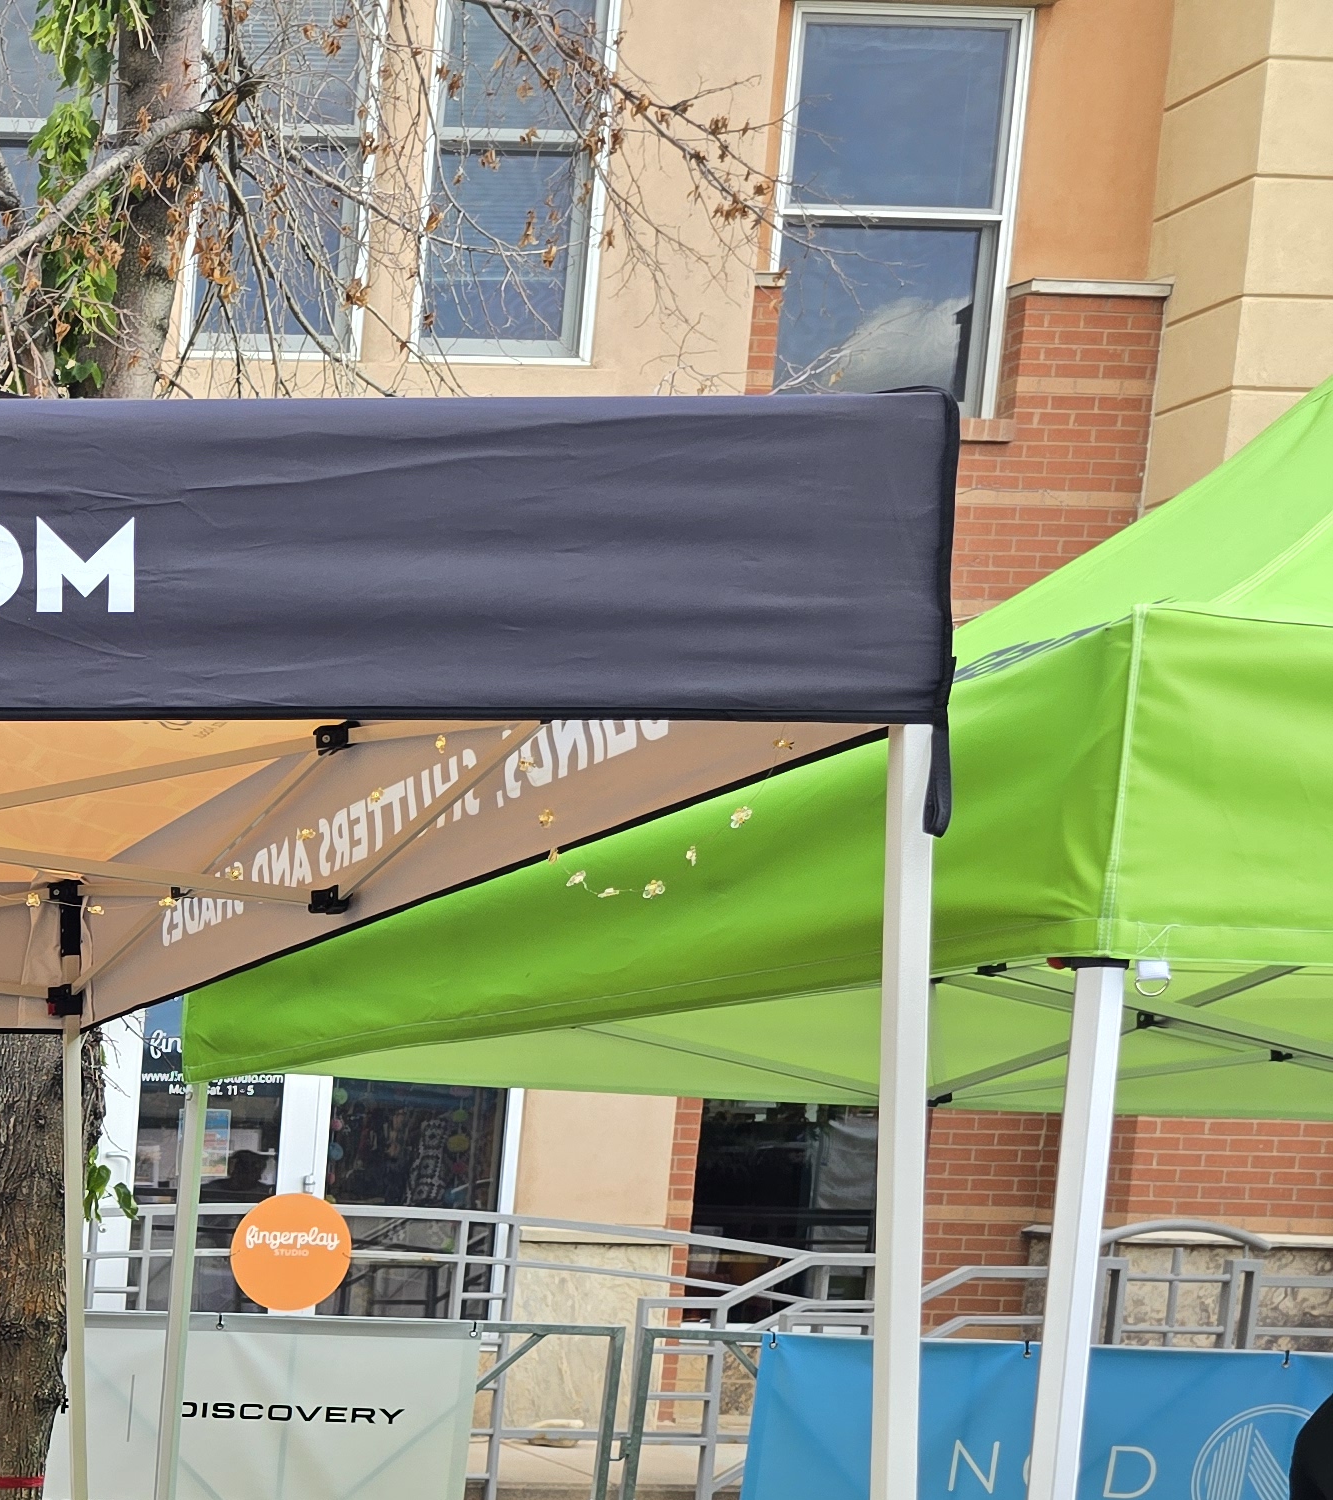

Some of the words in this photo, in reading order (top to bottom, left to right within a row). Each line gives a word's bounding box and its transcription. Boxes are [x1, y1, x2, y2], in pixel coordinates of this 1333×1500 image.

[244, 1225, 341, 1262] fingerplay
[273, 1248, 310, 1257] STUDIO
[181, 1401, 405, 1425] DISCOVERY
[947, 1439, 1158, 1500] ND
